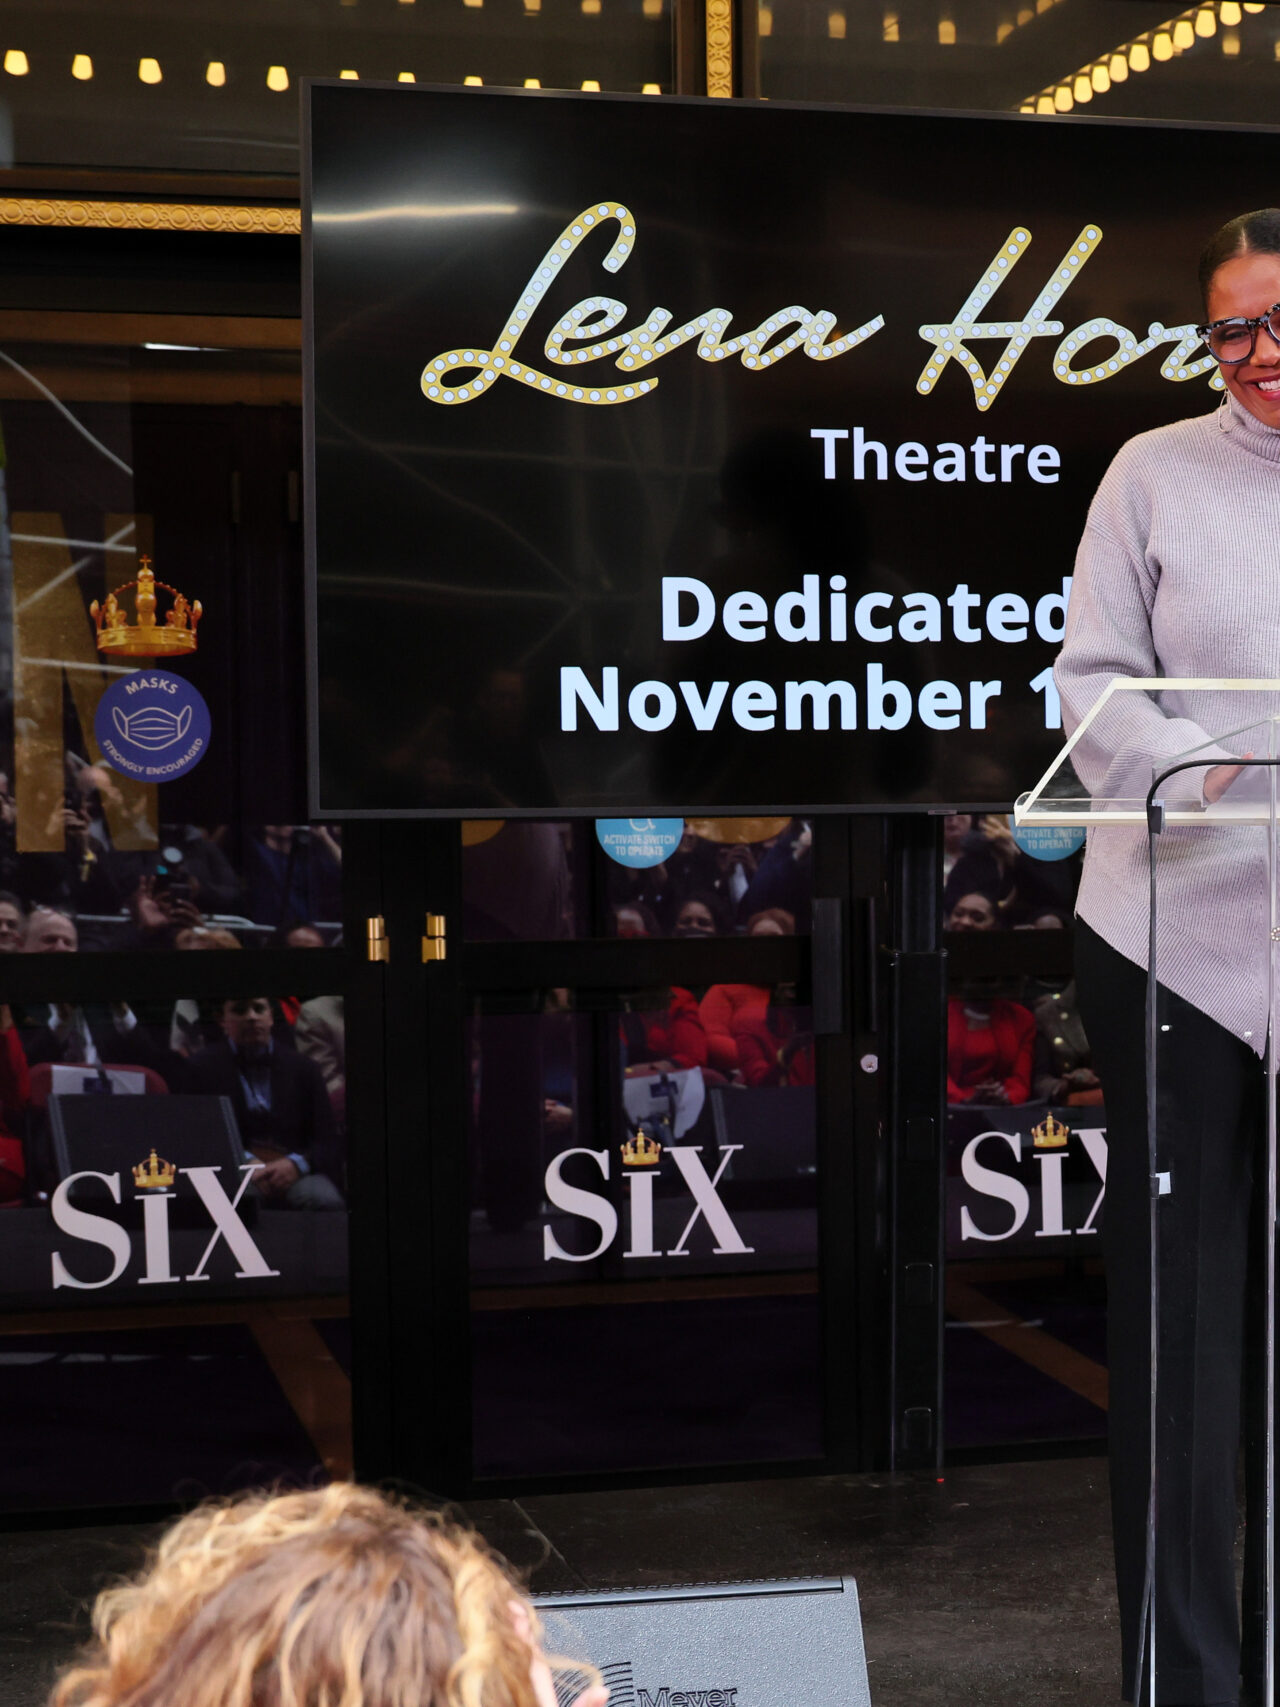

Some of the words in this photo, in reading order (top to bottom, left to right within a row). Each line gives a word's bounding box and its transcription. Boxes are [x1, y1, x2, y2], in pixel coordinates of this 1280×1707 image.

[420, 201, 886, 405] Lena
[810, 427, 1061, 483] Theatre
[661, 574, 1073, 643] Dedicated
[125, 677, 178, 695] MASKS
[560, 663, 1002, 732] November
[103, 739, 144, 773] STRONGLY
[146, 738, 203, 775] ENCOURAGED
[604, 834, 642, 845] ACTIVATE
[643, 834, 676, 845] SWITCH
[1016, 828, 1052, 839] ACTIVATE
[1027, 840, 1038, 849] TO
[1039, 839, 1073, 849] OPERATE
[615, 846, 626, 856] TO
[627, 846, 664, 856] OPERATE
[636, 1686, 738, 1707] Meyer
